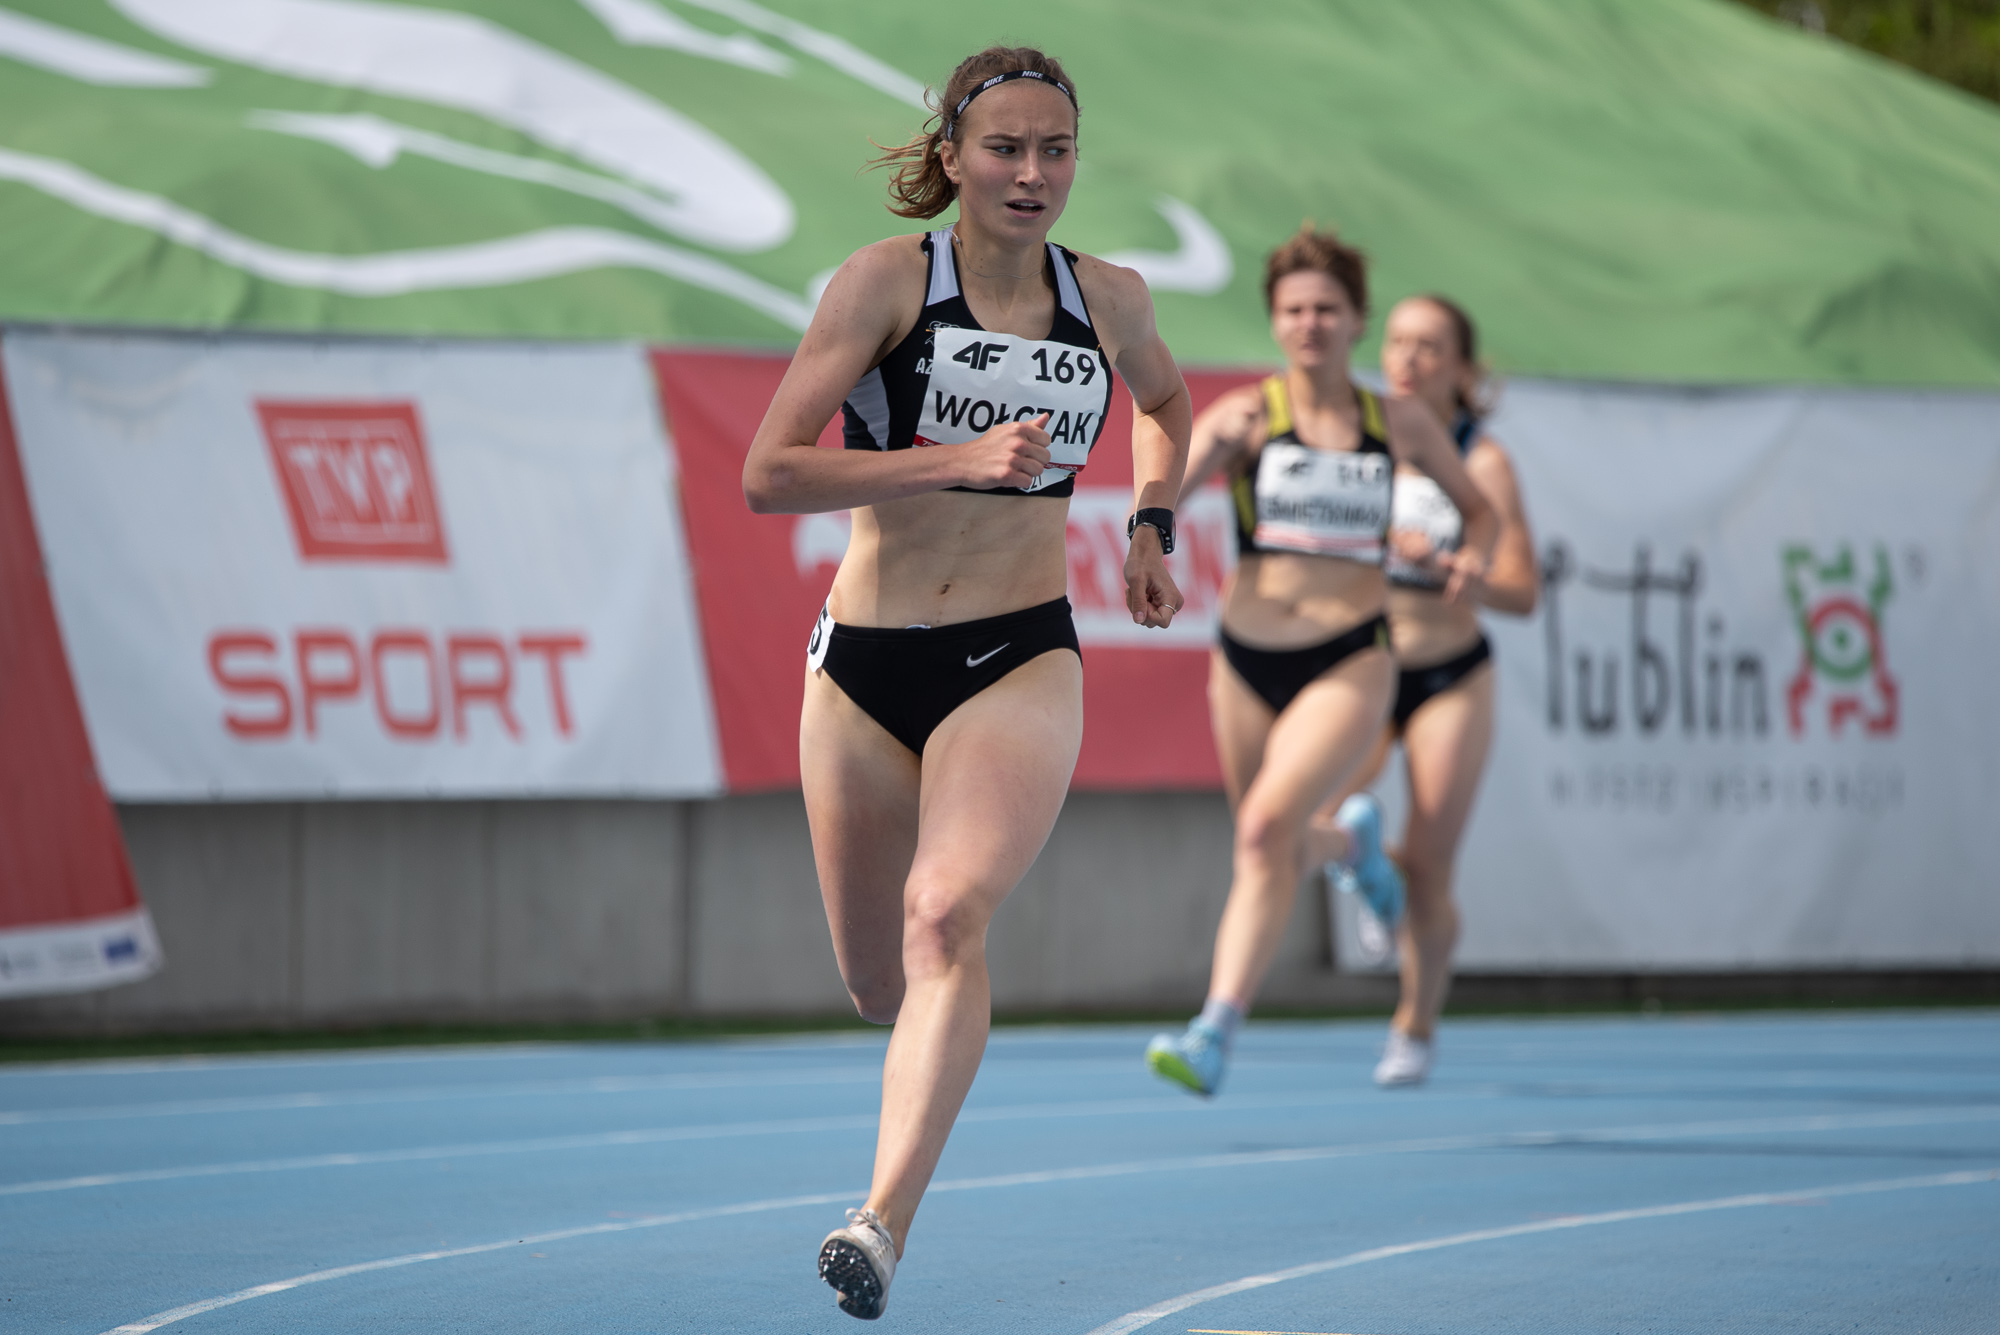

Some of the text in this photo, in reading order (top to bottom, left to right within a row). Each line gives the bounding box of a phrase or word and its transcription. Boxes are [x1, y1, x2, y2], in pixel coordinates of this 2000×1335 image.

[983, 74, 1005, 90] NIKE
[1021, 70, 1044, 79] NIKE
[957, 94, 970, 114] NIKE
[952, 341, 1096, 386] 4F 169
[277, 427, 428, 538] TVP
[206, 627, 588, 744] SPORT
